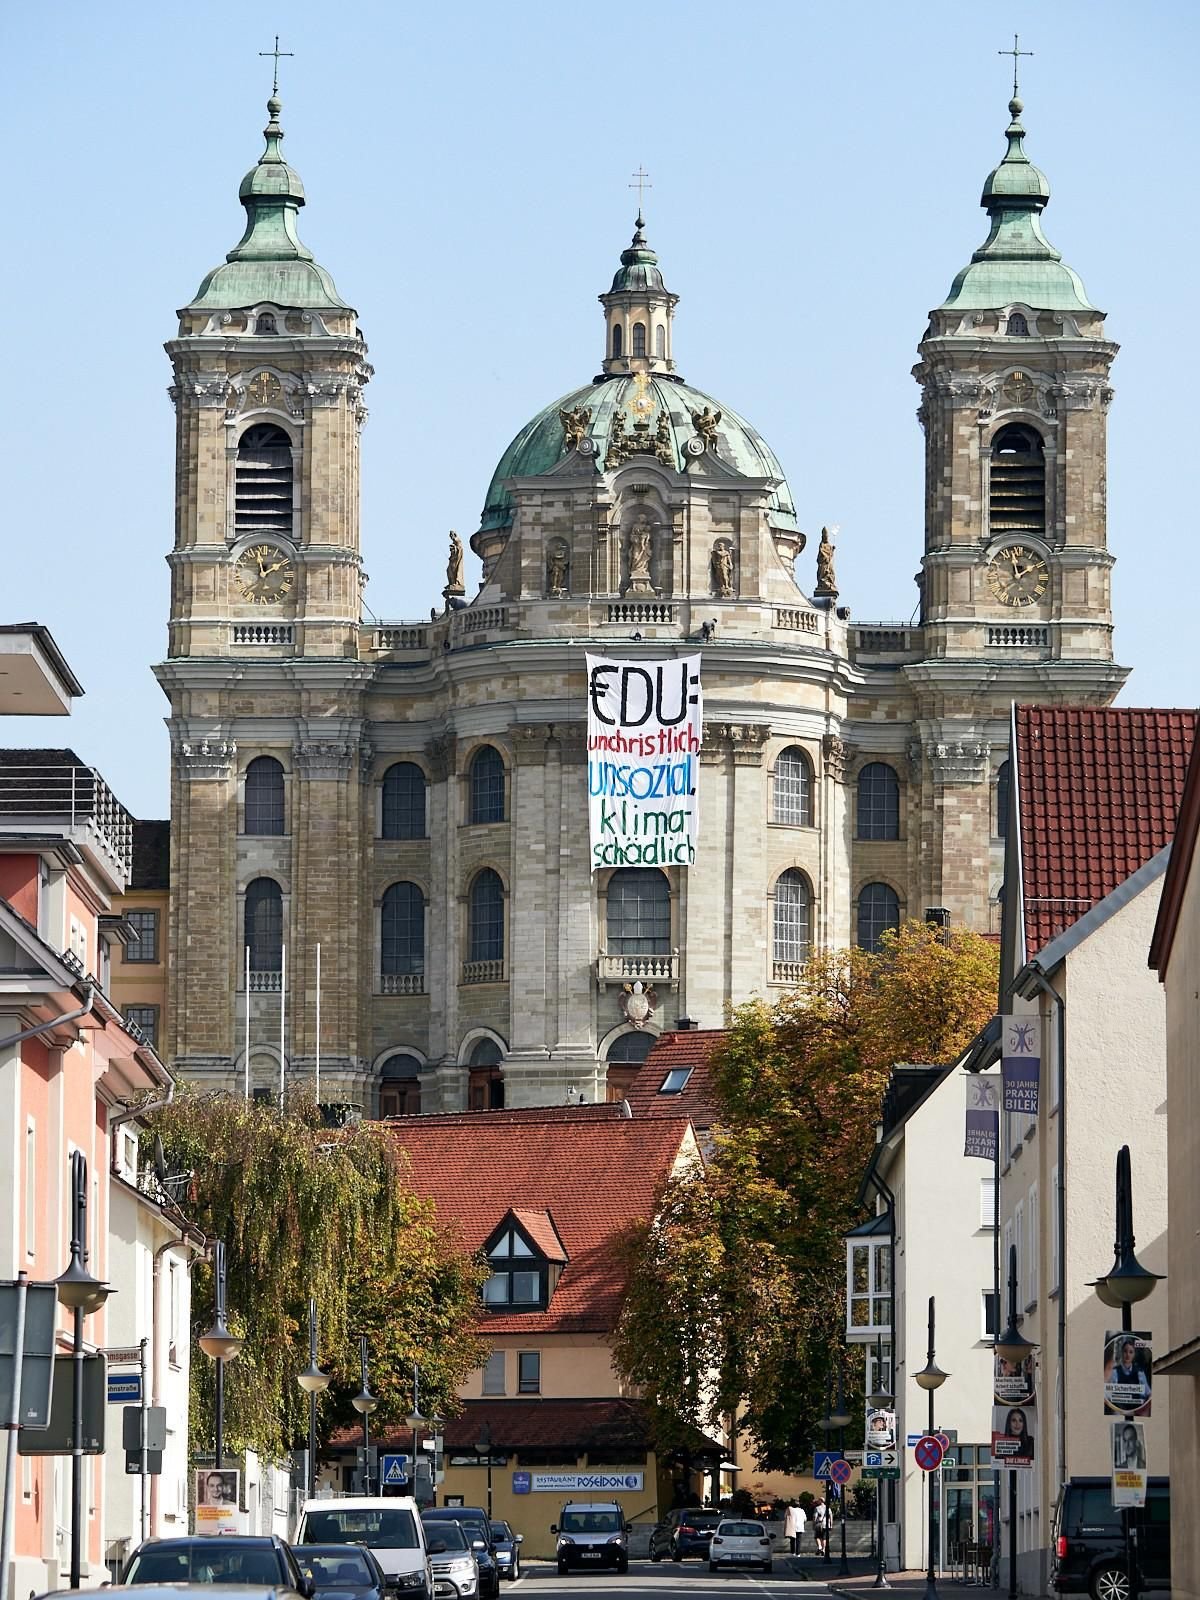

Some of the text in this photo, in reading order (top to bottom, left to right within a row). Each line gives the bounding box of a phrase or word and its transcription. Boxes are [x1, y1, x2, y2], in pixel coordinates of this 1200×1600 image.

[588, 723, 700, 756] unchristlich,
[600, 798, 692, 836] klima-
[594, 834, 696, 866] schädlich
[1005, 1090, 1038, 1099] PRAXIS
[1005, 1098, 1037, 1111] BILEK
